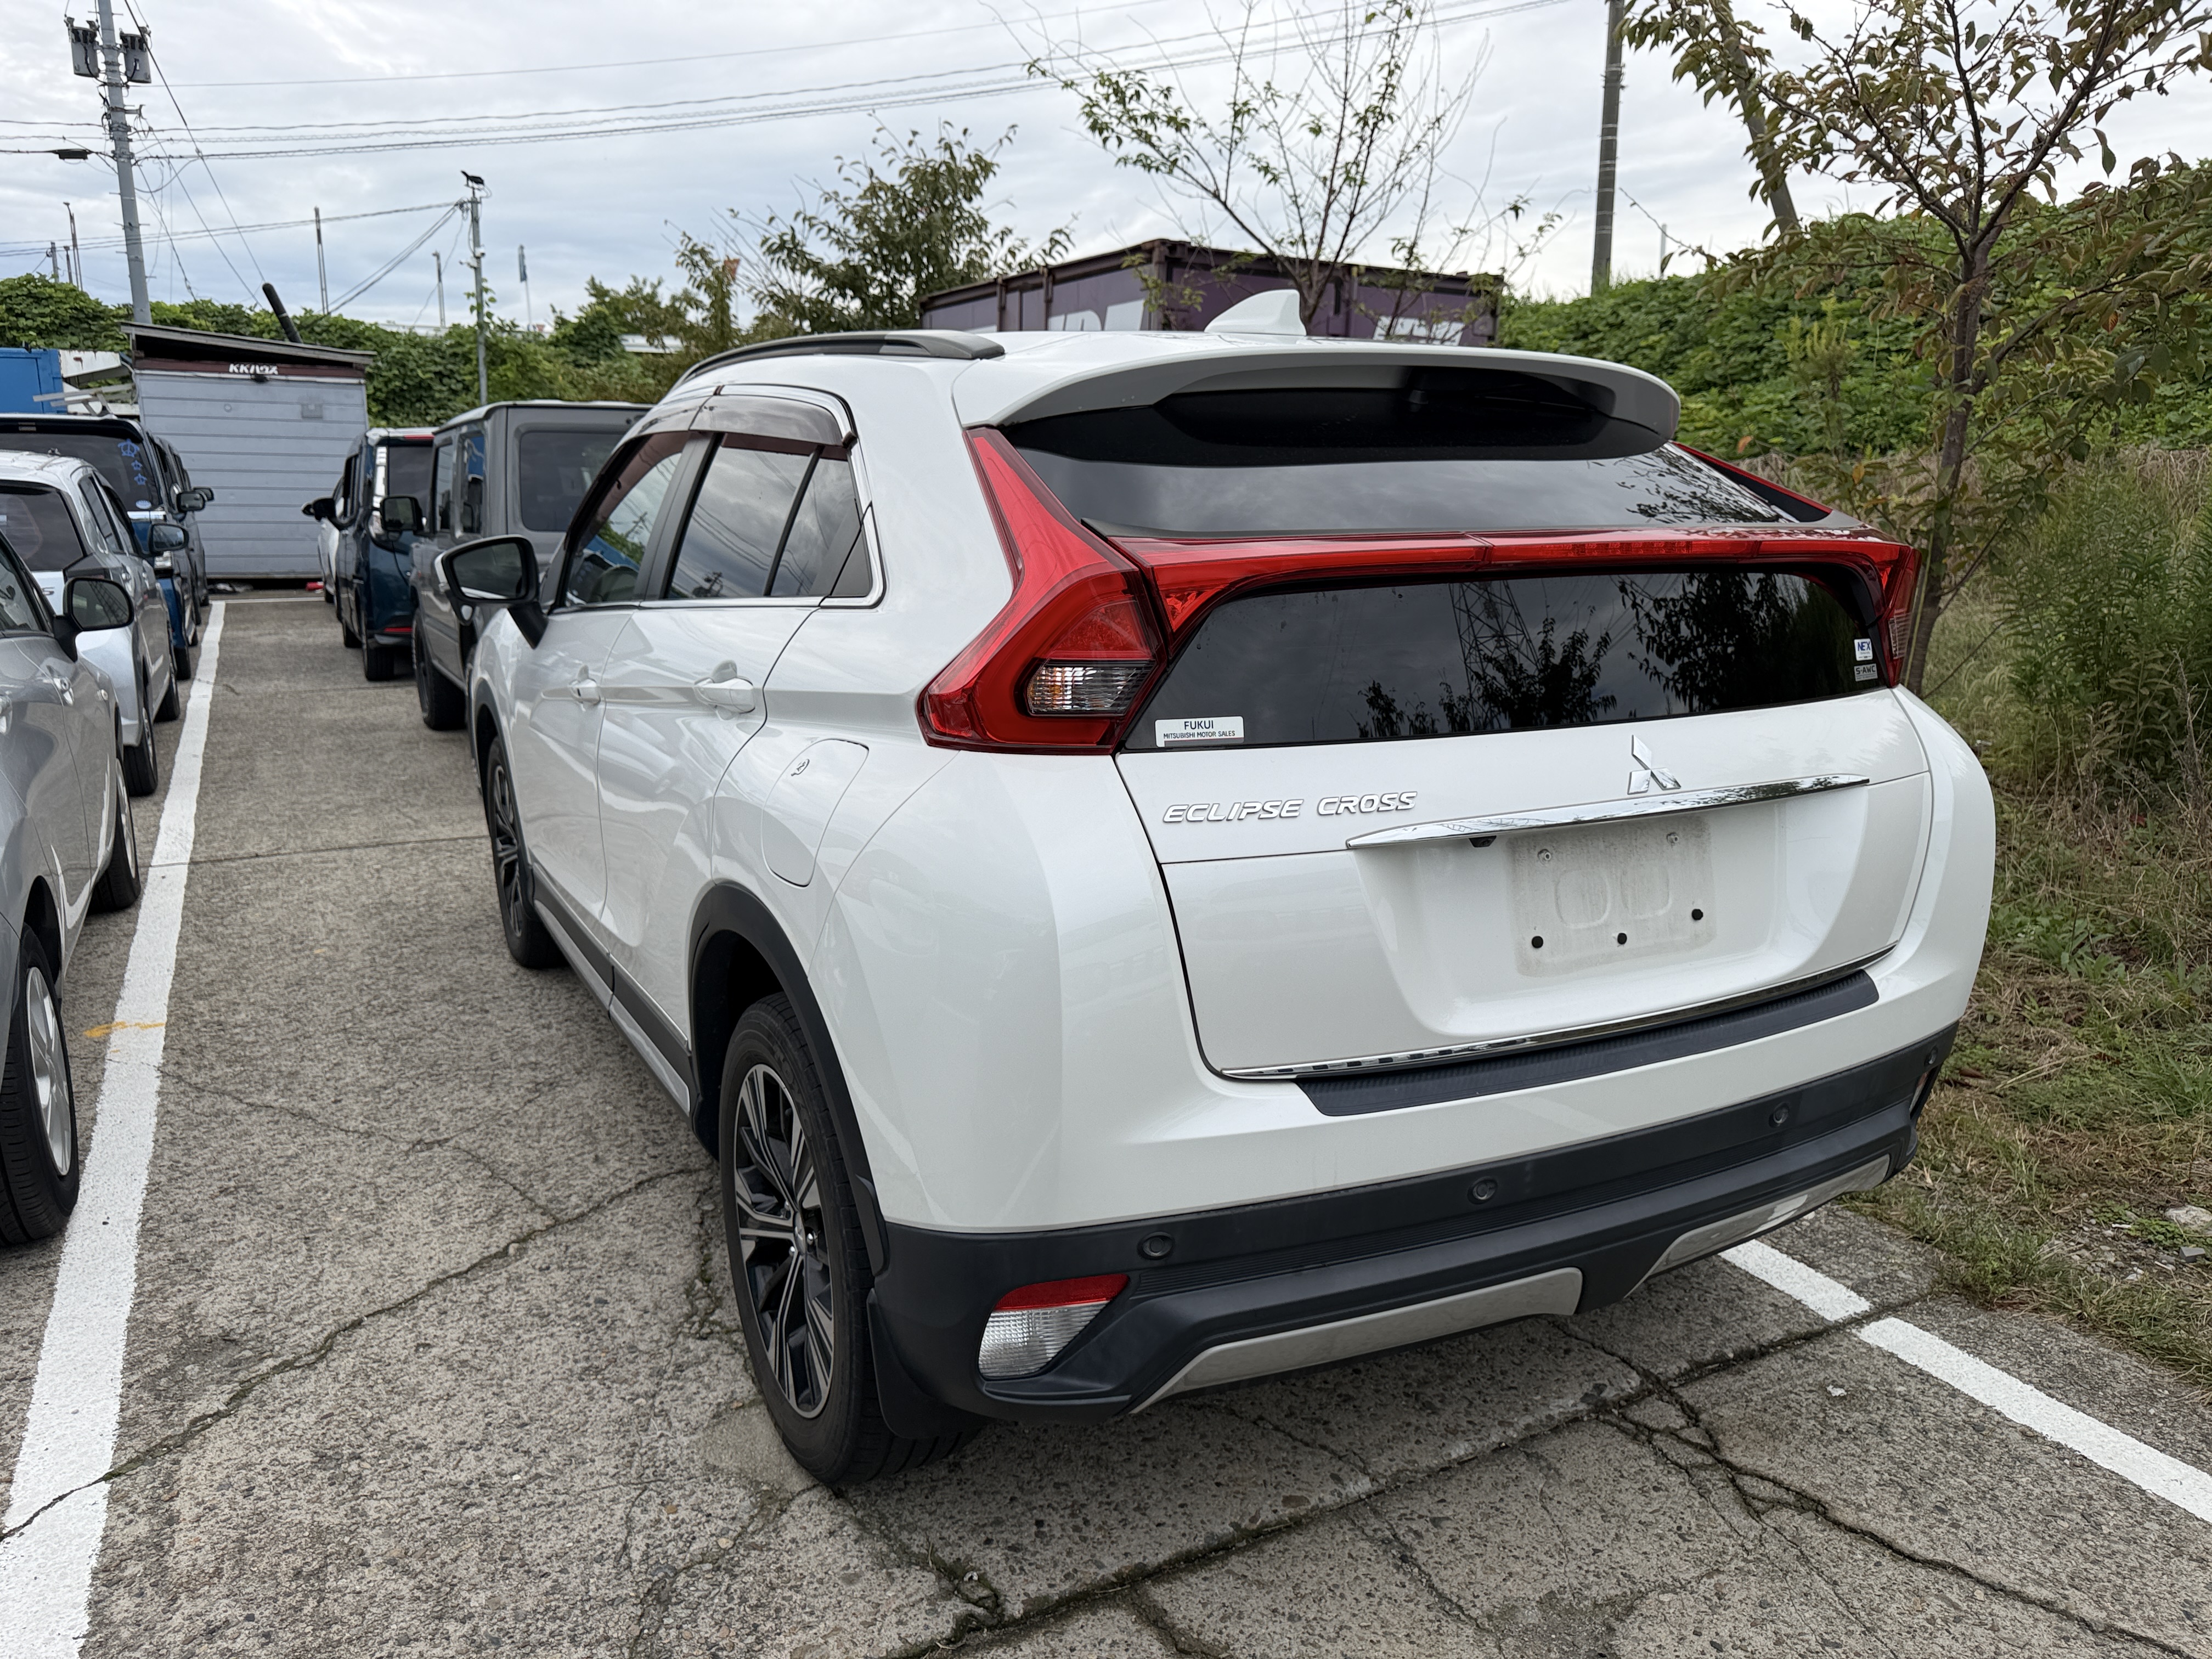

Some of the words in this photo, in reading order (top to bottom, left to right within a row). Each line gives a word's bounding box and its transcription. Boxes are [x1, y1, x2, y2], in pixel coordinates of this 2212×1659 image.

[1858, 641, 1870, 651] NEX
[1856, 665, 1876, 674] S-AWC
[1184, 720, 1214, 730] FUKUI
[1162, 799, 1305, 823] ECLIPSE
[1316, 791, 1418, 815] CROSS
[772, 1043, 813, 1138] TOYO
